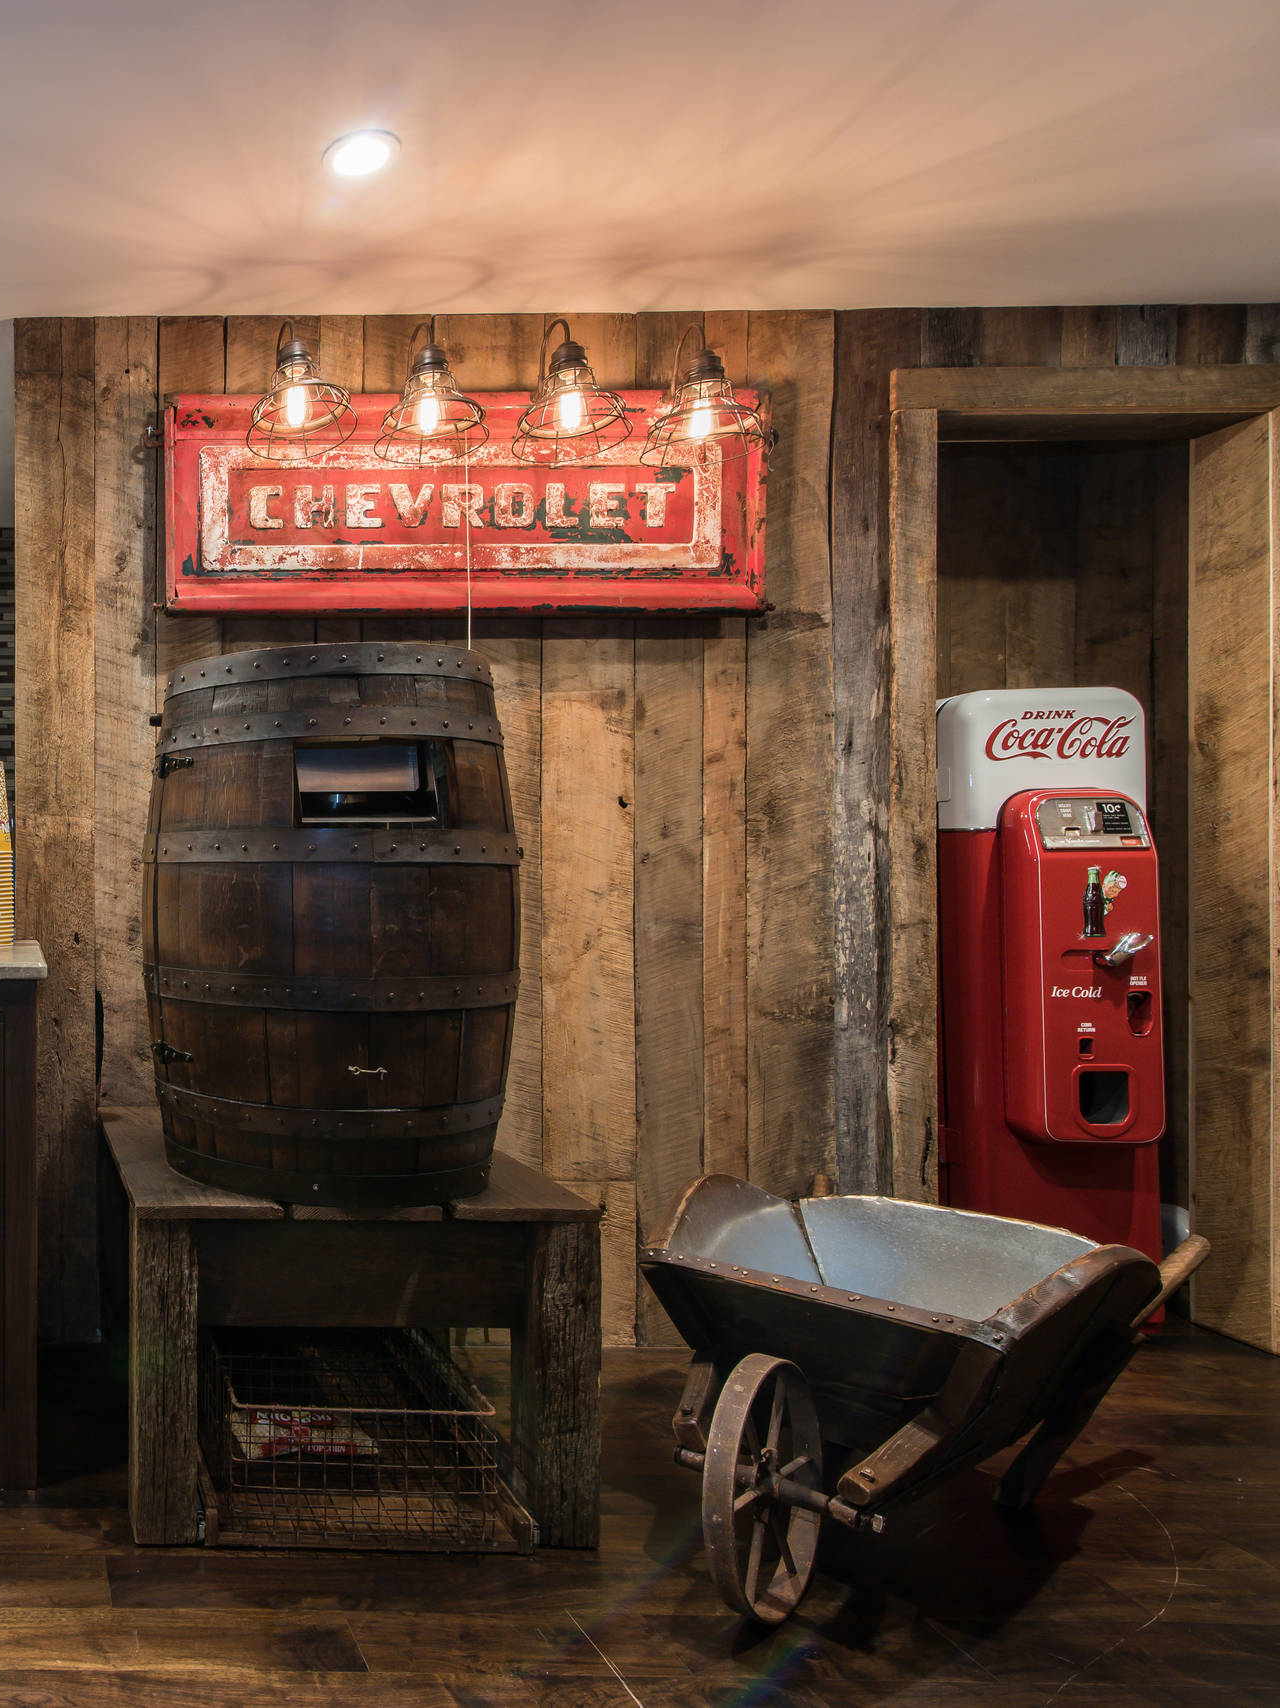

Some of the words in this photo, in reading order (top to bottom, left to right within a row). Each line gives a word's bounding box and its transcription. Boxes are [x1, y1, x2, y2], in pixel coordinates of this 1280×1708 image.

[248, 482, 676, 529] CHEVROLET
[1020, 710, 1076, 720] DRINK
[985, 714, 1136, 761] Coca-Cola
[1051, 986, 1070, 998] Ice
[1071, 986, 1102, 998] Cold
